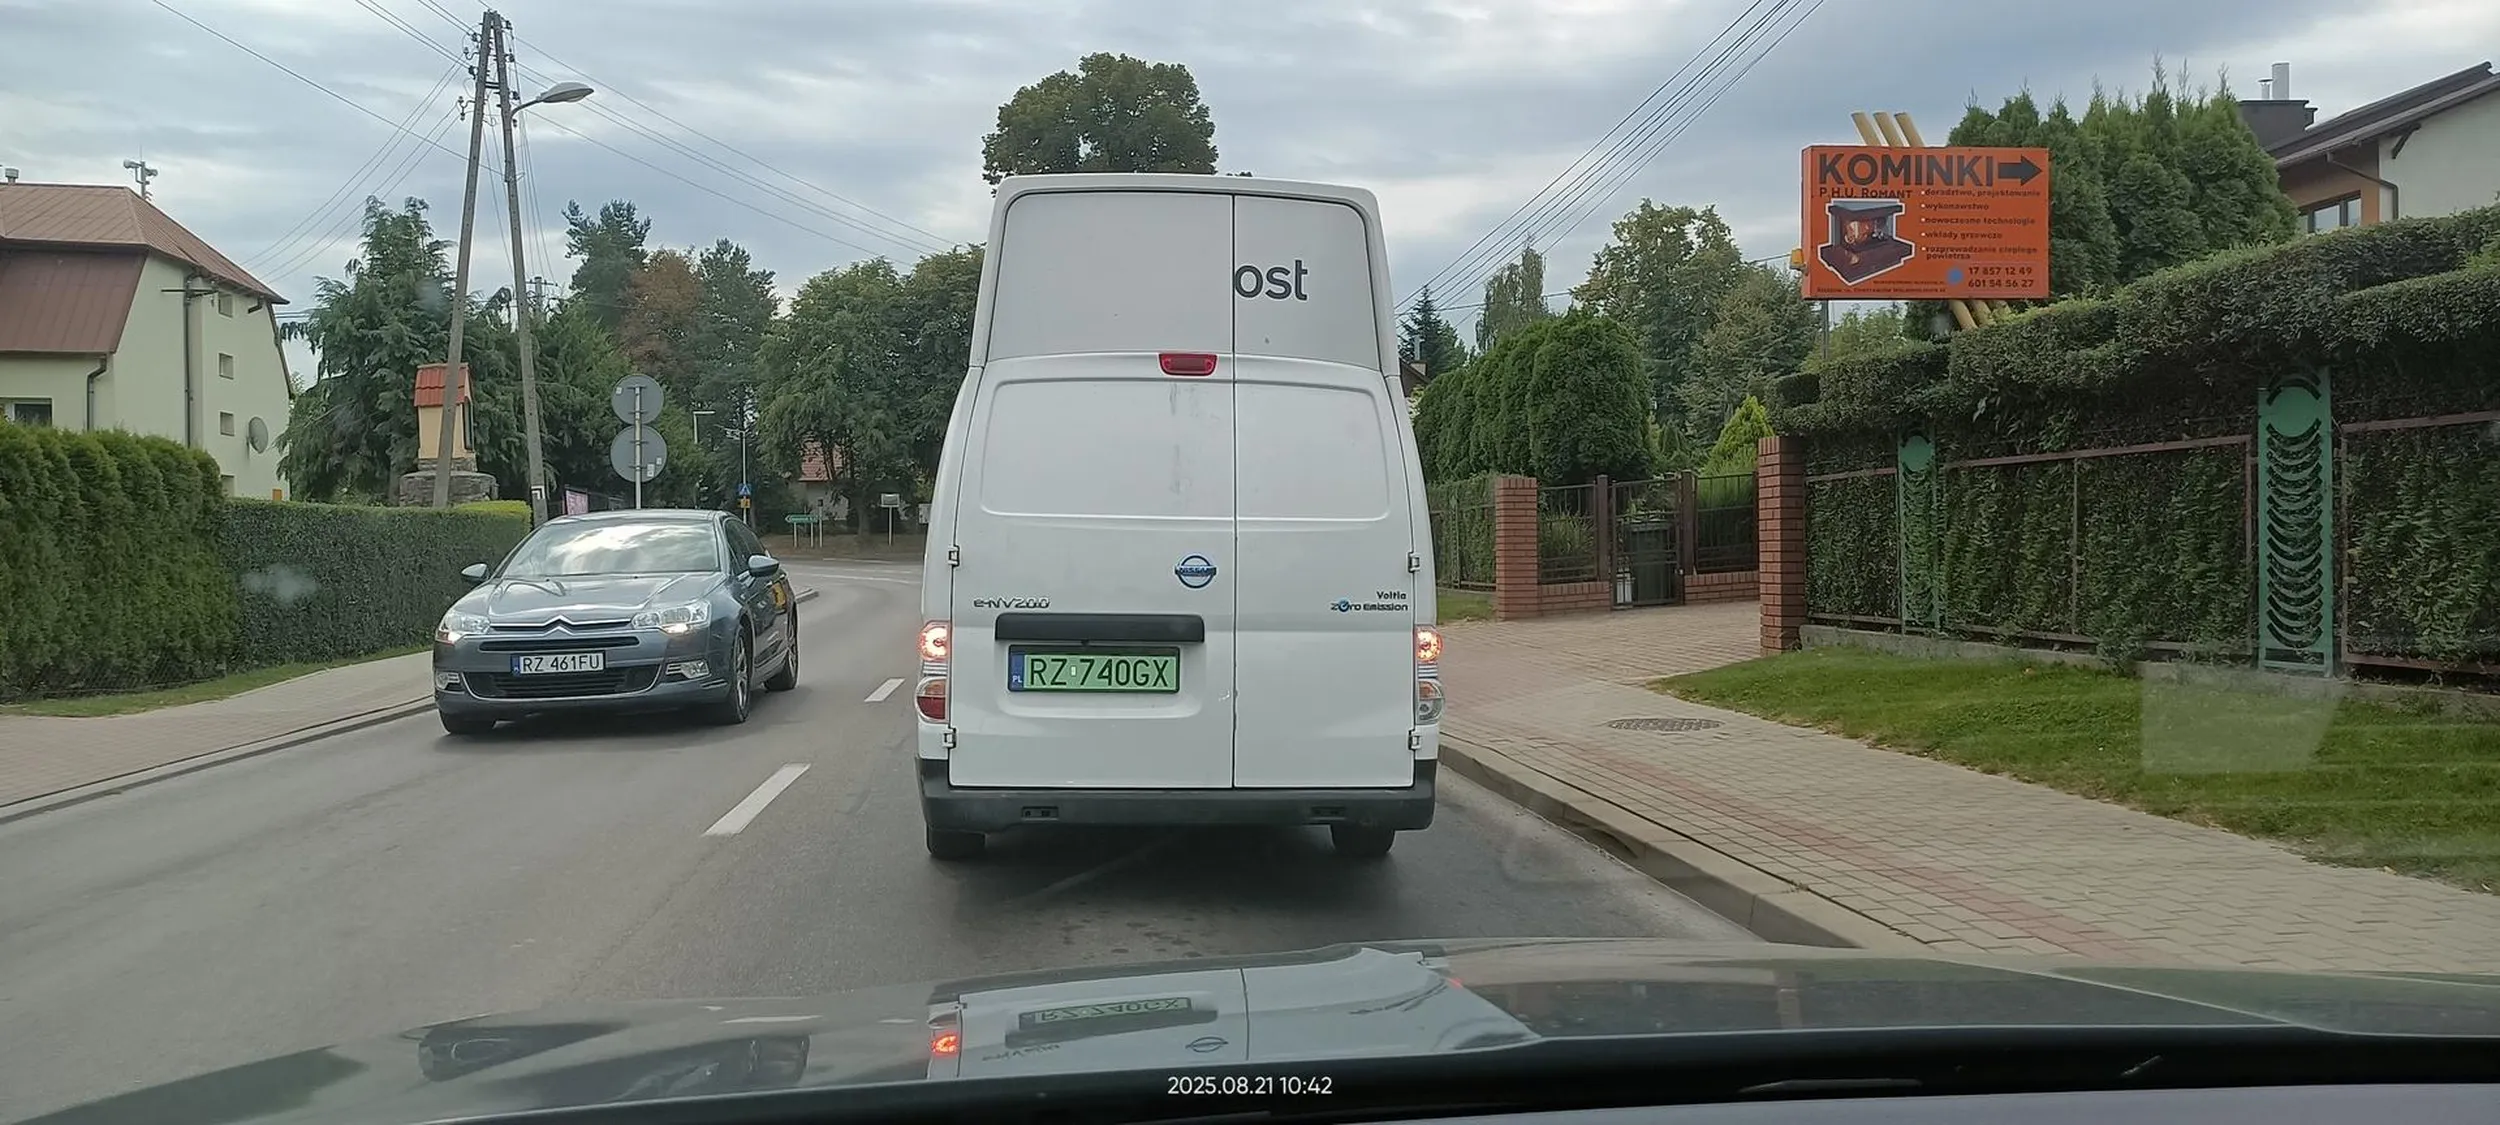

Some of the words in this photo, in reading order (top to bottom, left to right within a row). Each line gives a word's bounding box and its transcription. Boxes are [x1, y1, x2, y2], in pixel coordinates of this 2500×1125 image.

[1819, 153, 1994, 187] KOMINKI
[1819, 187, 1857, 198] P.H.U.
[1968, 266, 1980, 275] 17
[2005, 266, 2016, 275] 12
[2018, 266, 2033, 275] 49
[1234, 259, 1308, 300] ost
[1968, 279, 1987, 288] 601
[2020, 279, 2034, 288] 27
[1376, 590, 1406, 600] Voltia
[522, 656, 544, 672] RZ
[550, 654, 600, 671] 461FU
[1029, 658, 1068, 686] RZ
[1079, 658, 1170, 687] 740GX
[1012, 675, 1023, 683] PL
